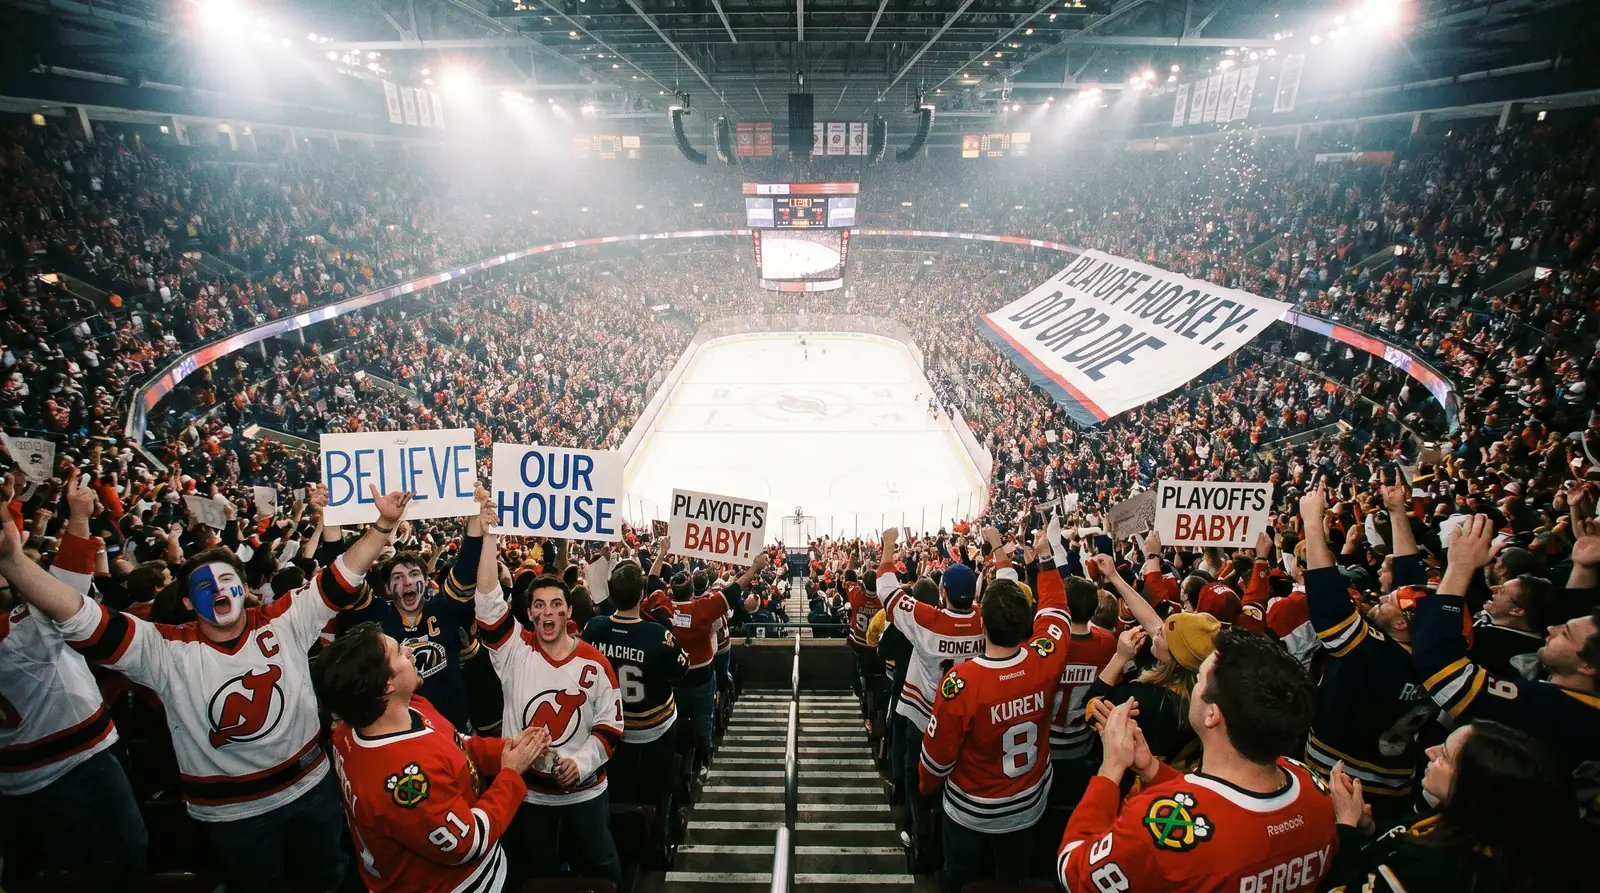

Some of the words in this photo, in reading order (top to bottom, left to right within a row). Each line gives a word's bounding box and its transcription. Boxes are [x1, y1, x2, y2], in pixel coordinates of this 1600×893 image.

[1008, 290, 1076, 330] DO
[1057, 255, 1152, 306] PLAYOFF
[1123, 279, 1258, 351] HOCKEY:
[1035, 307, 1110, 352] OR
[1061, 323, 1168, 382] DIE
[325, 445, 475, 507] BELIEVE
[520, 451, 594, 492] OUR
[497, 490, 616, 535] HOUSE
[673, 494, 764, 529] PLAYOFFS
[1161, 486, 1267, 511] PLAYOFFS
[684, 522, 751, 558] BABY!
[1174, 513, 1249, 542] BABY!
[256, 629, 280, 658] C
[427, 615, 441, 637] C
[1047, 623, 1063, 641] 8
[578, 664, 598, 689] C
[926, 714, 938, 739] 8
[990, 690, 1045, 725] KUREN
[1002, 720, 1039, 779] 8
[428, 811, 471, 852] 91
[1089, 831, 1130, 893] 98
